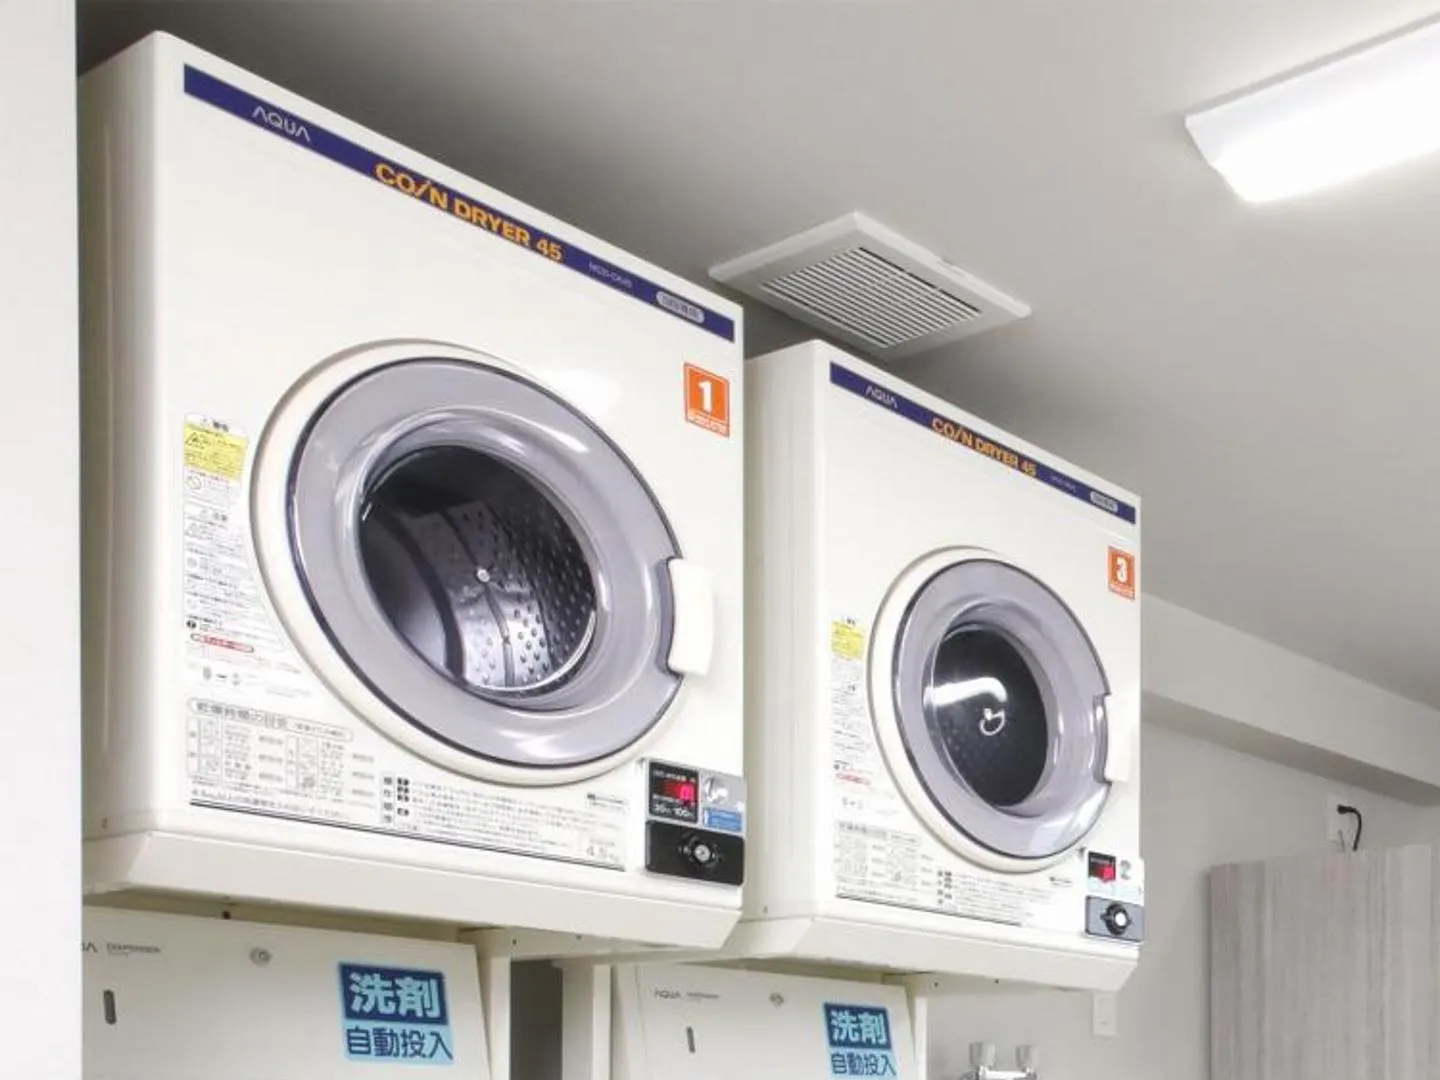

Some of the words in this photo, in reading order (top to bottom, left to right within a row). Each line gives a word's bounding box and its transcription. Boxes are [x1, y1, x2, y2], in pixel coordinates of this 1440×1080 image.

[252, 106, 311, 142] AQUA
[454, 198, 531, 246] DRYER
[537, 238, 562, 262] 45
[698, 380, 713, 413] 1
[865, 384, 898, 409] AQUA
[975, 436, 1019, 468] DRYER
[1020, 458, 1037, 478] 45
[1116, 556, 1128, 583] 3
[350, 972, 440, 1018] 洗剤
[347, 1025, 453, 1060] 自動投入
[831, 1009, 887, 1044] 洗剤
[831, 1052, 897, 1077] 自動投入
